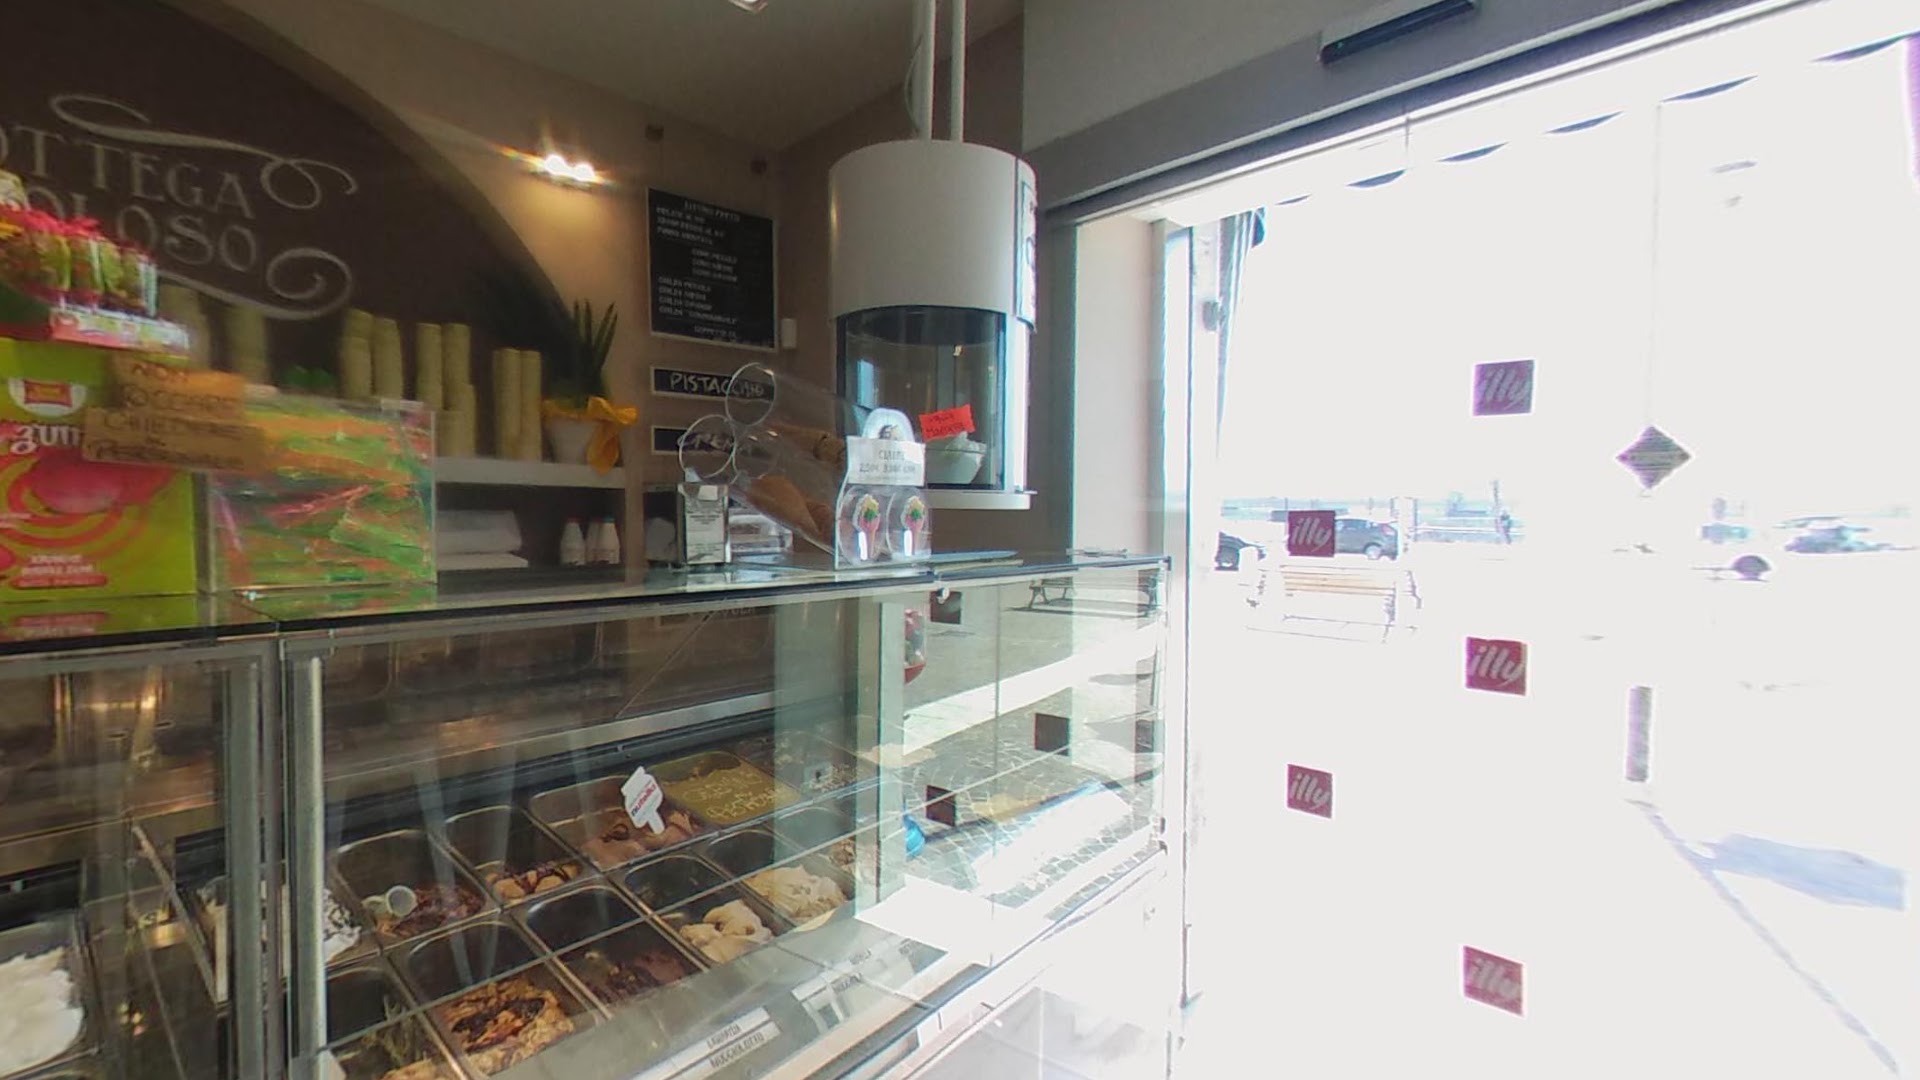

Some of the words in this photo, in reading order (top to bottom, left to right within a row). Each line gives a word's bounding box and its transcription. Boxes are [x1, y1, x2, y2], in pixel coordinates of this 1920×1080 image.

[1478, 366, 1531, 411] illy
[1290, 516, 1332, 553] illy
[1470, 645, 1525, 688] illy
[1289, 771, 1330, 810] illy
[1465, 956, 1521, 1002] illy
